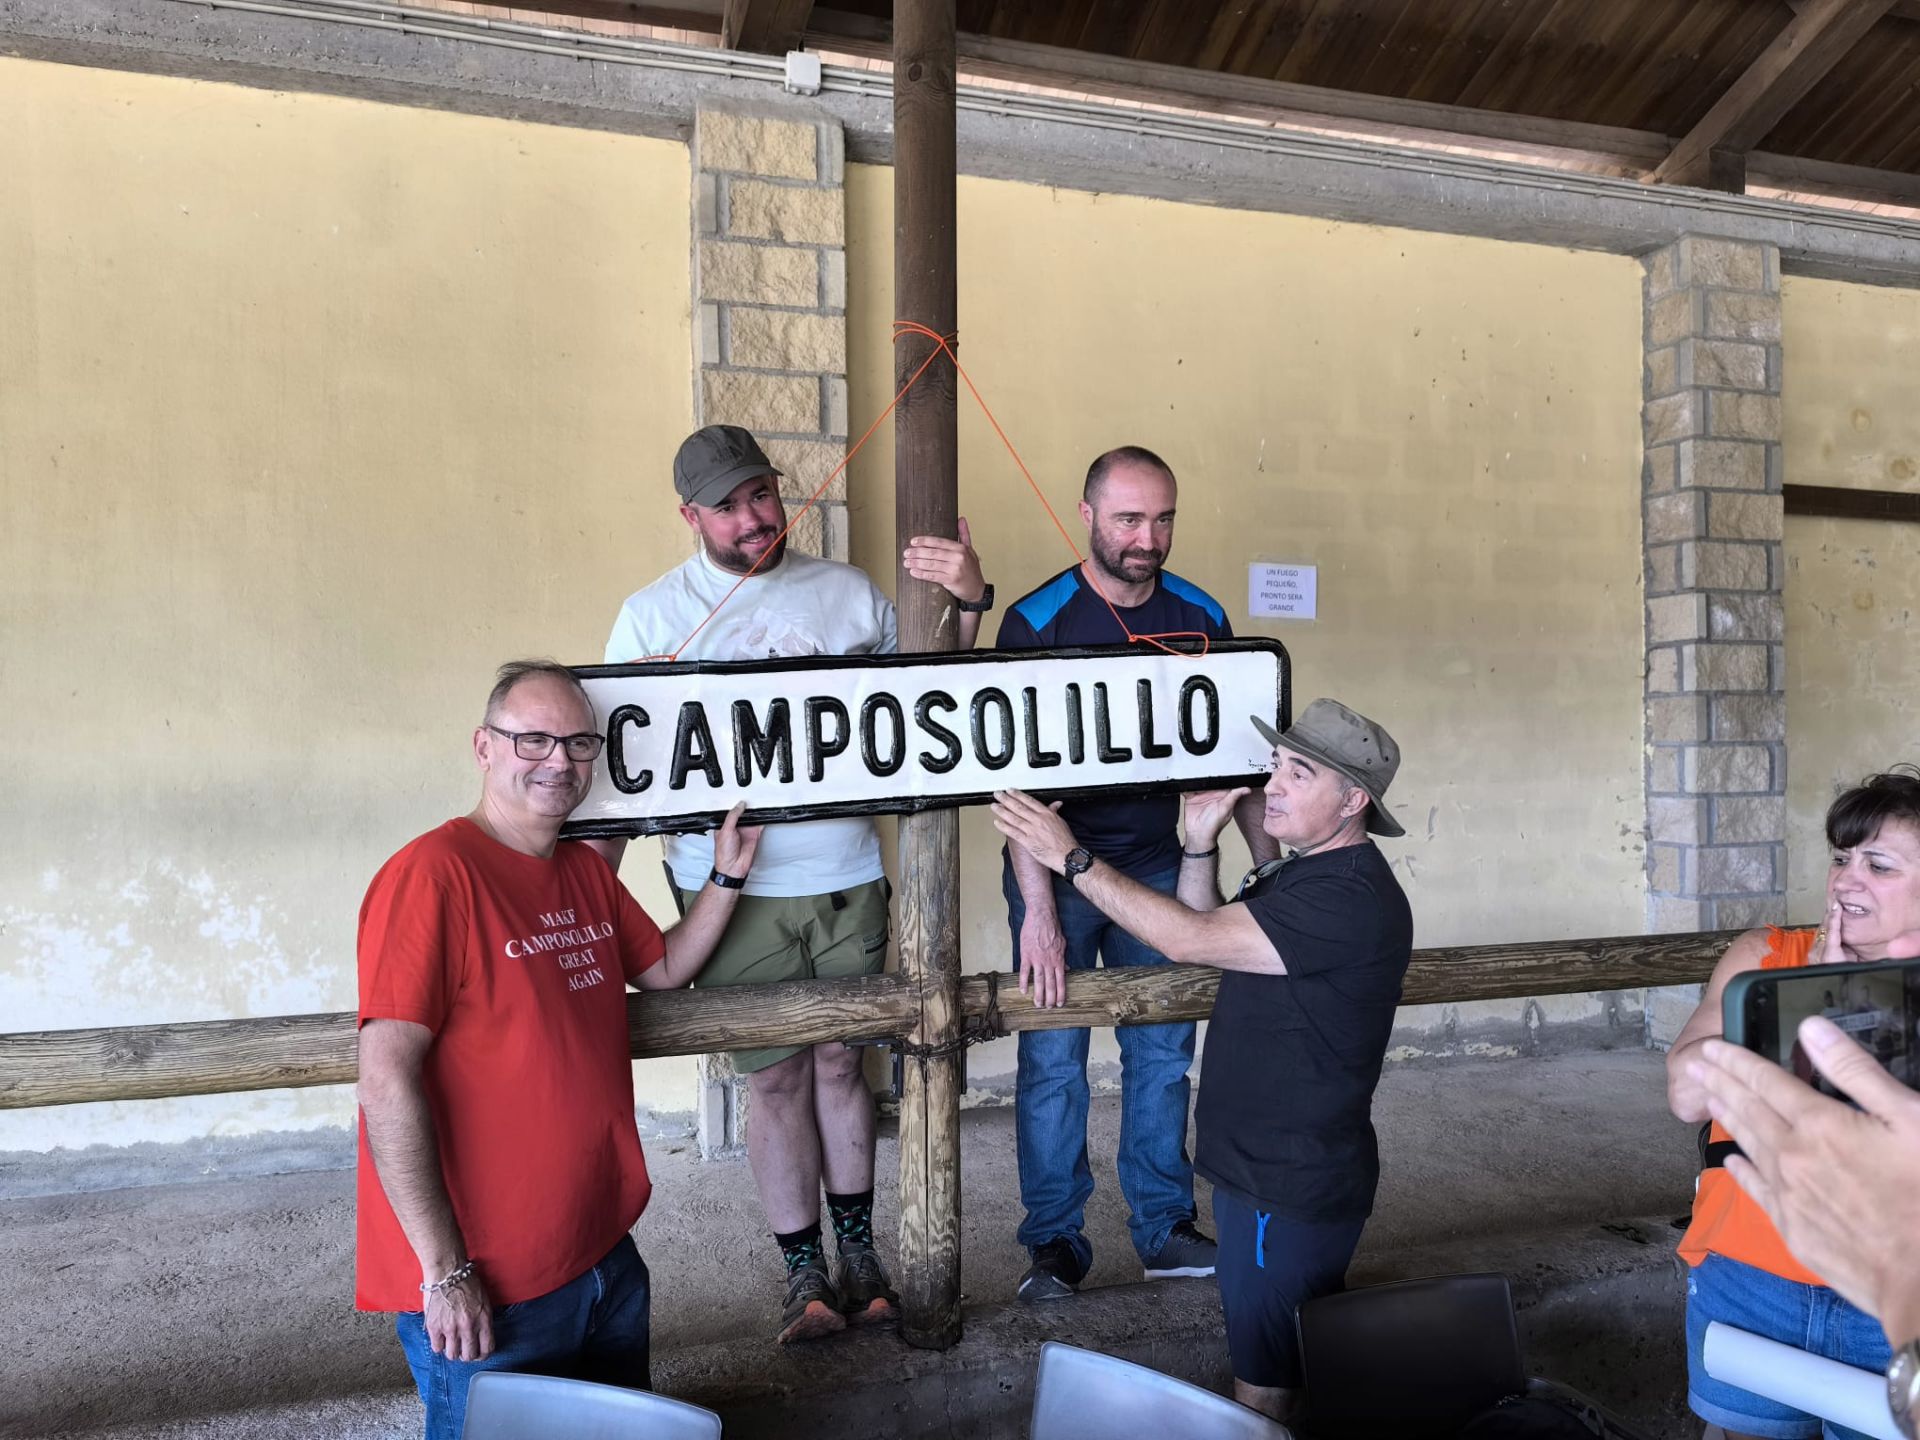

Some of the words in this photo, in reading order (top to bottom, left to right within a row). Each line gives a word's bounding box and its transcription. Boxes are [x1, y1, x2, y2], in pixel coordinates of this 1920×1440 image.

[1277, 569, 1299, 577] FUEGO
[1260, 592, 1287, 600] PRONTO
[1268, 604, 1295, 612] GRANDE
[606, 674, 1220, 794] CAMPOSOLILLO
[558, 948, 596, 970] GREAT
[568, 967, 605, 992] AGAIN
